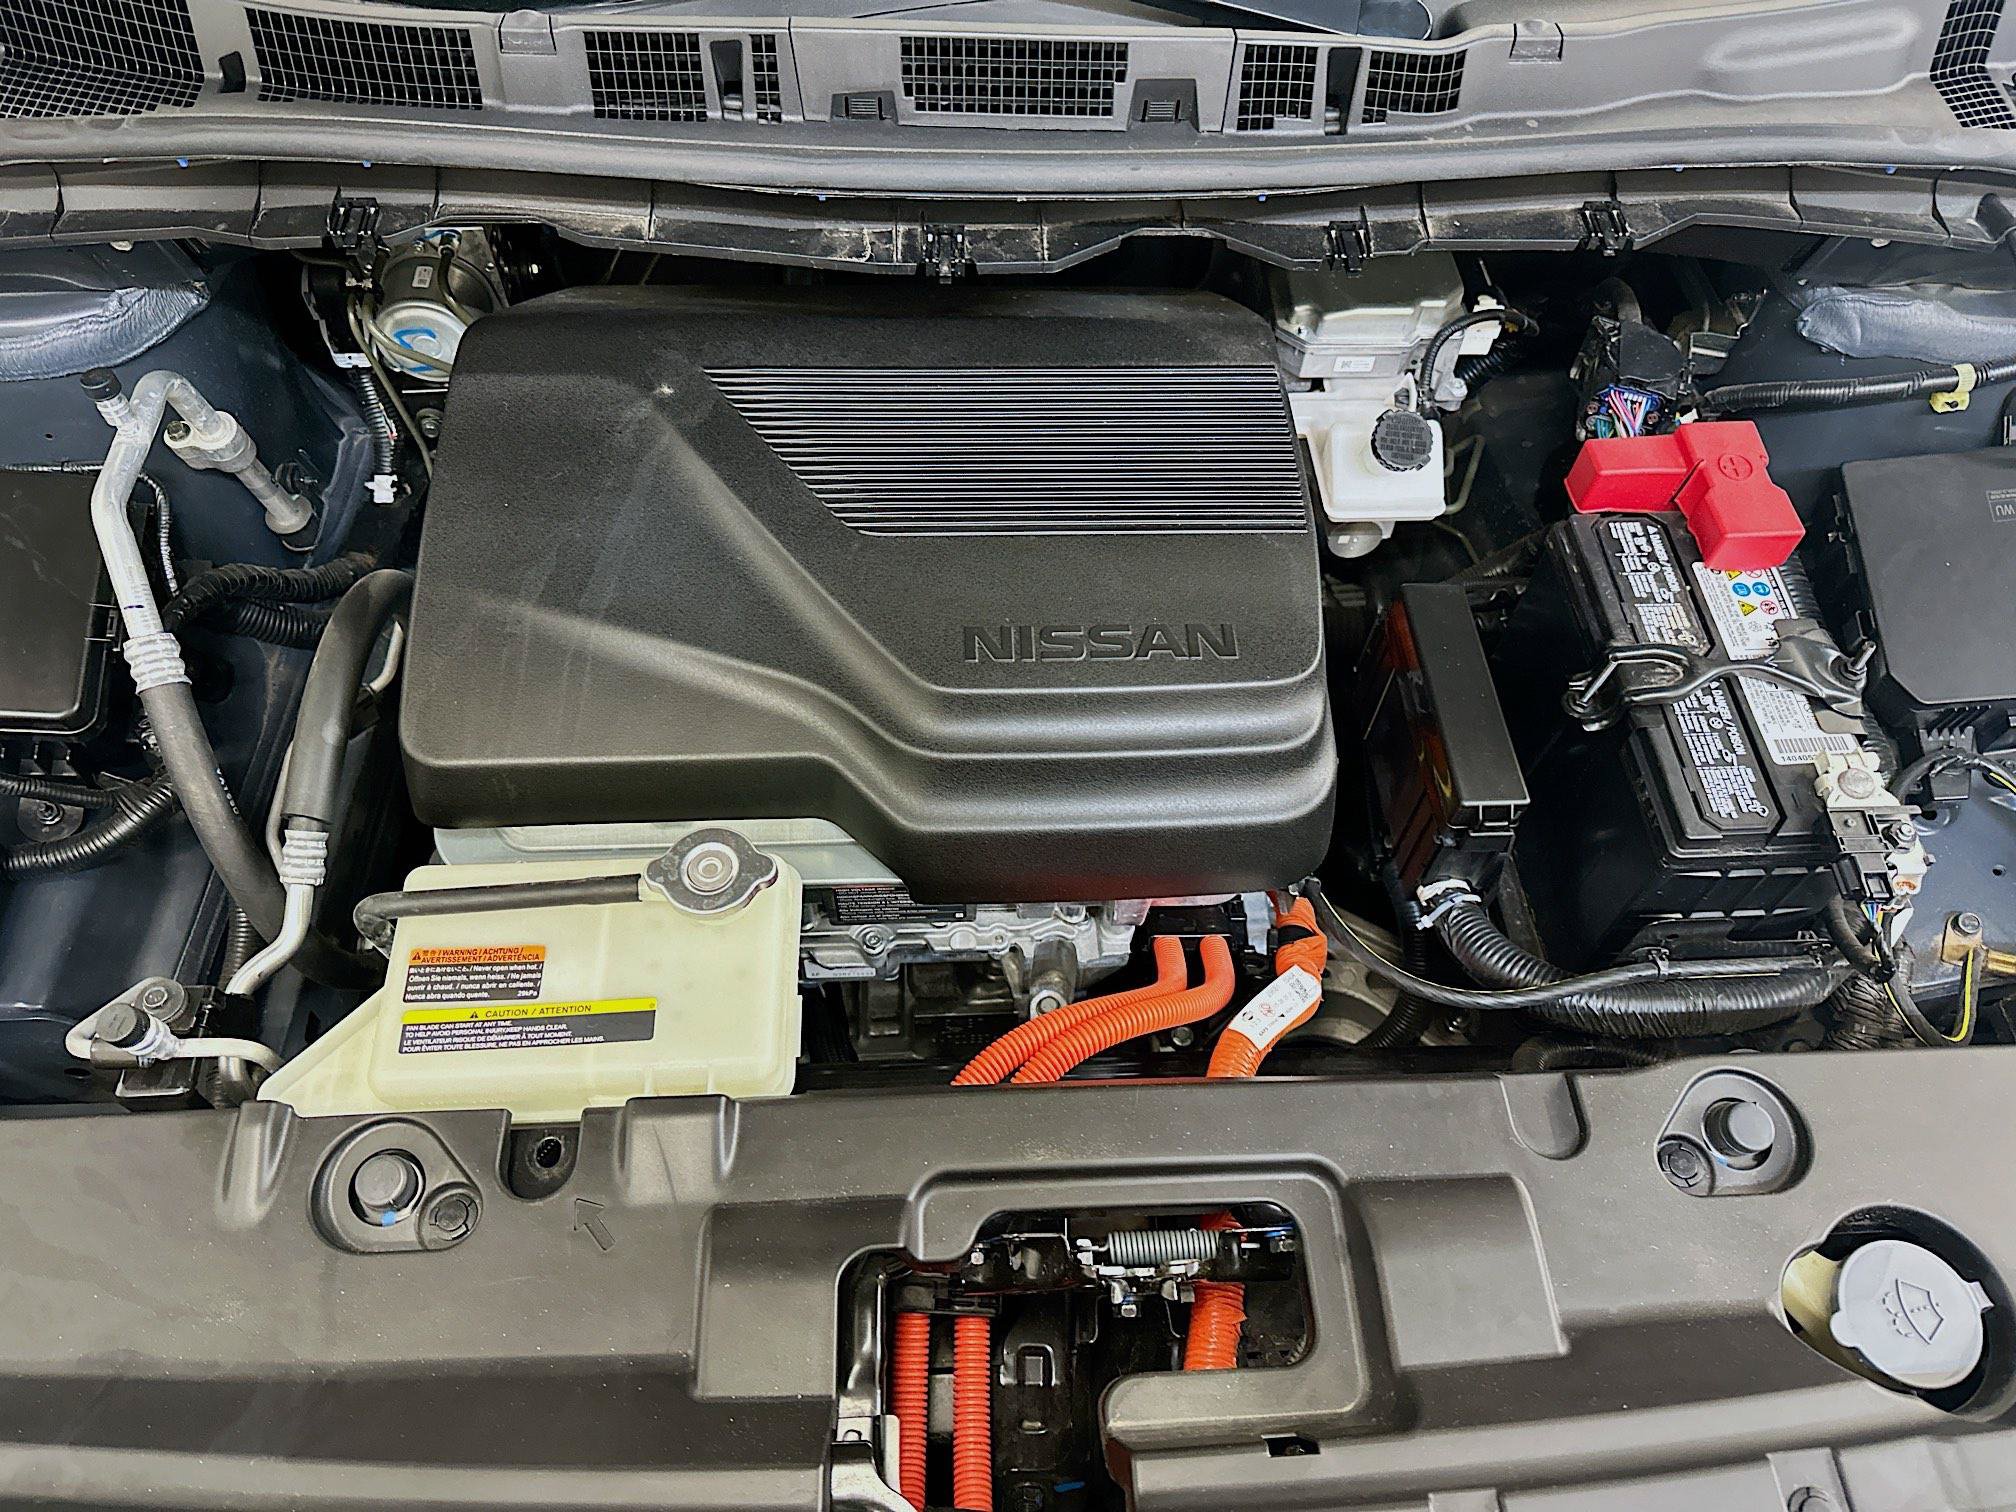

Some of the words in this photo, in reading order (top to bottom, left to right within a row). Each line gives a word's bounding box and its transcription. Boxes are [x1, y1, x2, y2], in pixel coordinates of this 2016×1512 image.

[964, 623, 1239, 662] NISSAN
[492, 965, 508, 973] open
[520, 972, 541, 980] jamais
[427, 992, 440, 1000] abra
[442, 992, 465, 1000] quando
[485, 1008, 528, 1018] CAUTION
[538, 1004, 592, 1015] ATTENTION
[452, 1028, 484, 1036] PERSONAL
[523, 1024, 545, 1032] HANDS
[413, 1037, 452, 1045] VENTILATEUR
[452, 1035, 476, 1043] RISQUE
[528, 1031, 544, 1039] TOUT
[531, 1038, 570, 1046] APPROCHER
